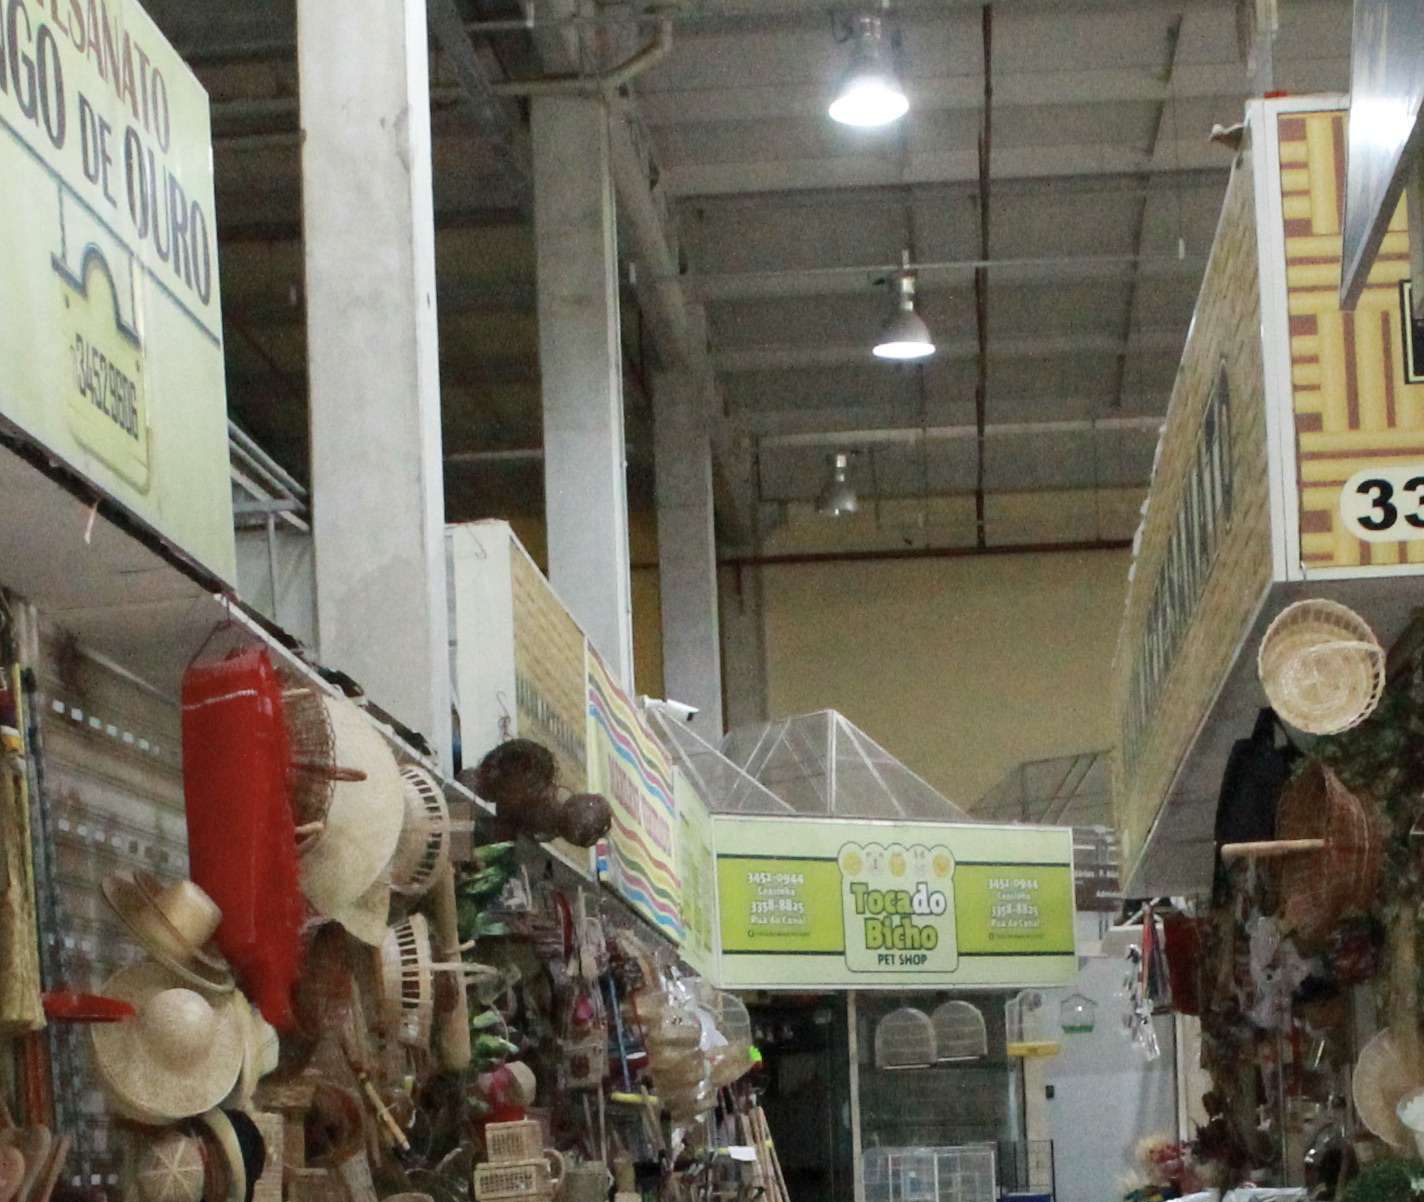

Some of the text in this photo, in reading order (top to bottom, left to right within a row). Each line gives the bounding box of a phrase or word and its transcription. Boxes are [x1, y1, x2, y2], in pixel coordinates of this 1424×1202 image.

[78, 90, 117, 210] DE
[124, 124, 212, 308] OURO
[864, 915, 938, 950] Bicho
[878, 953, 928, 966] PET SHOP
